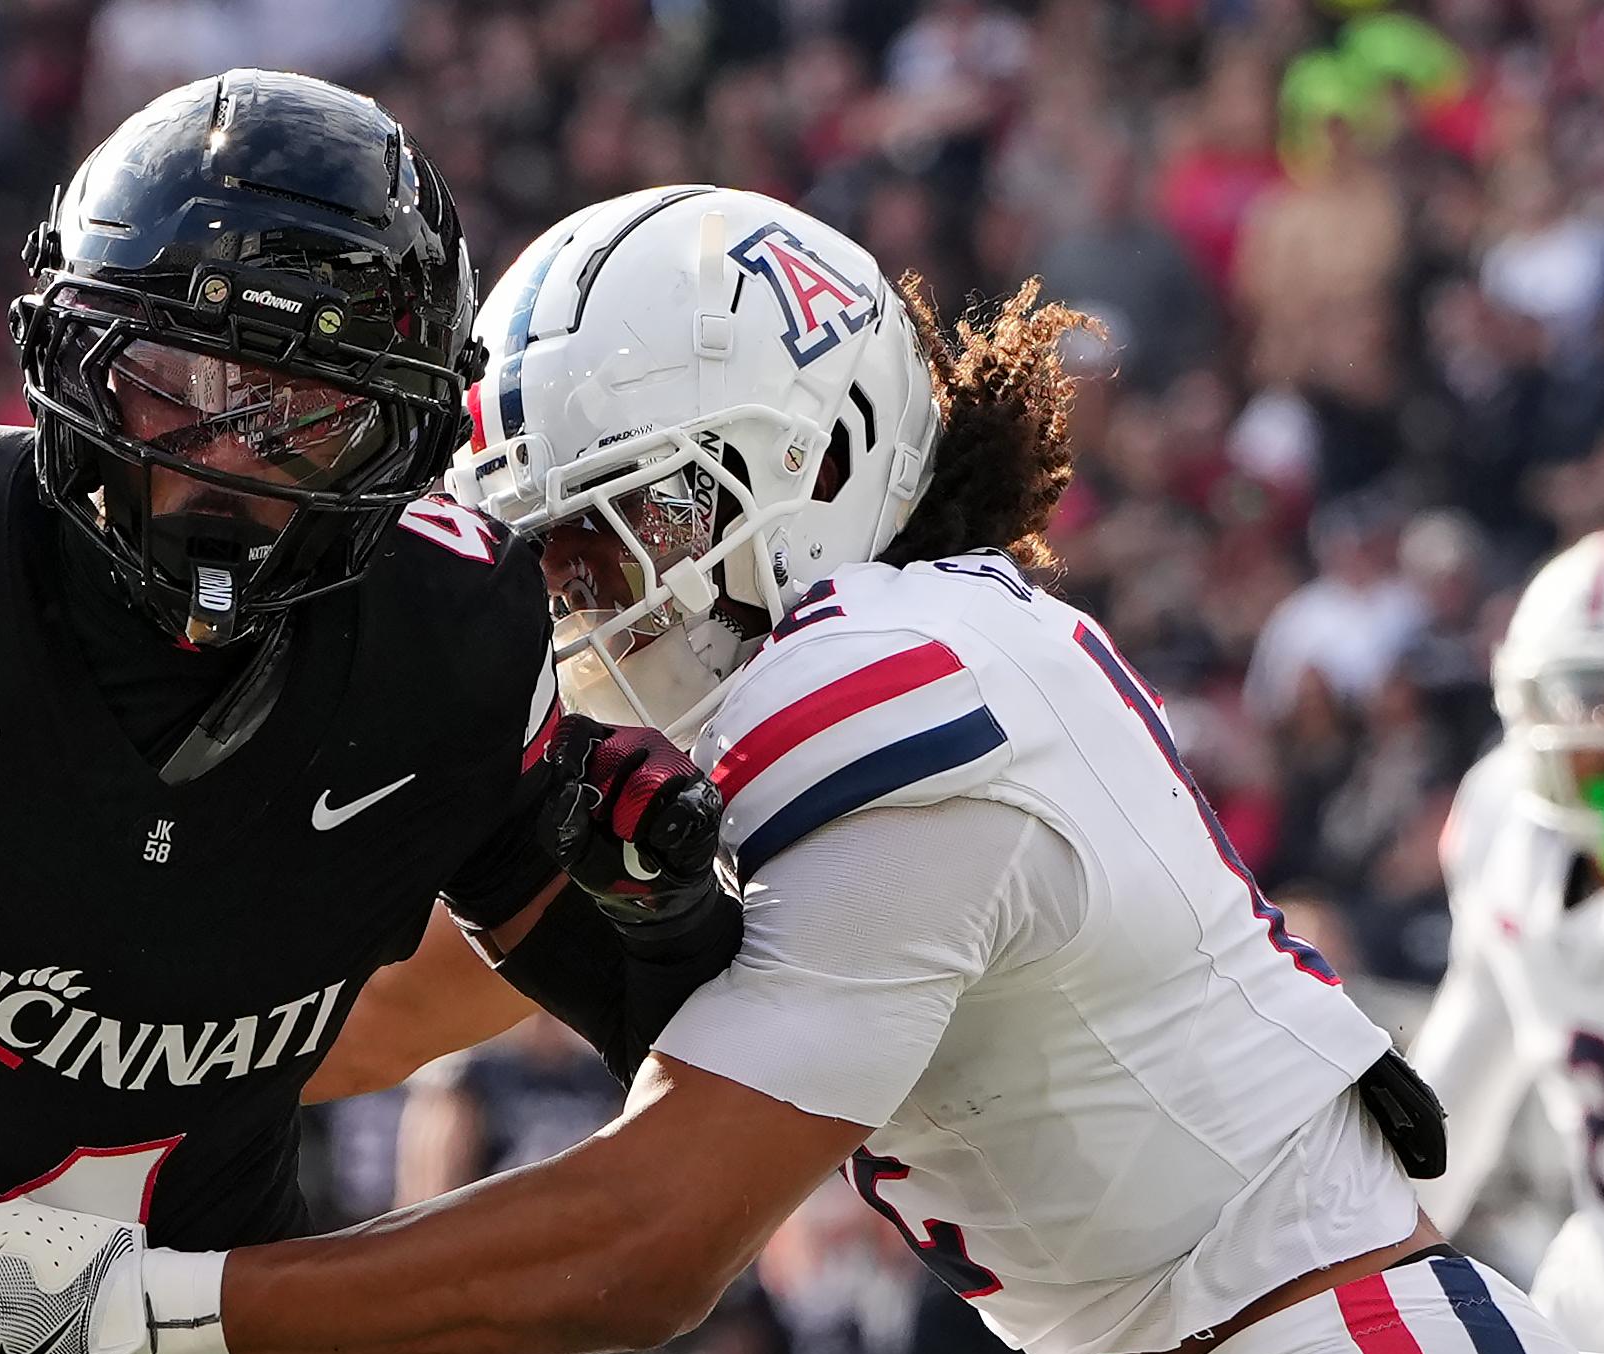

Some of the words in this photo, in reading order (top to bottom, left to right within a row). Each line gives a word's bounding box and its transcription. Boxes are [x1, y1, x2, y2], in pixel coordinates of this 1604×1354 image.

[242, 289, 303, 314] CINCINNATI
[727, 222, 880, 370] A
[396, 493, 501, 565] 4
[148, 819, 175, 841] JK
[143, 840, 171, 863] 58
